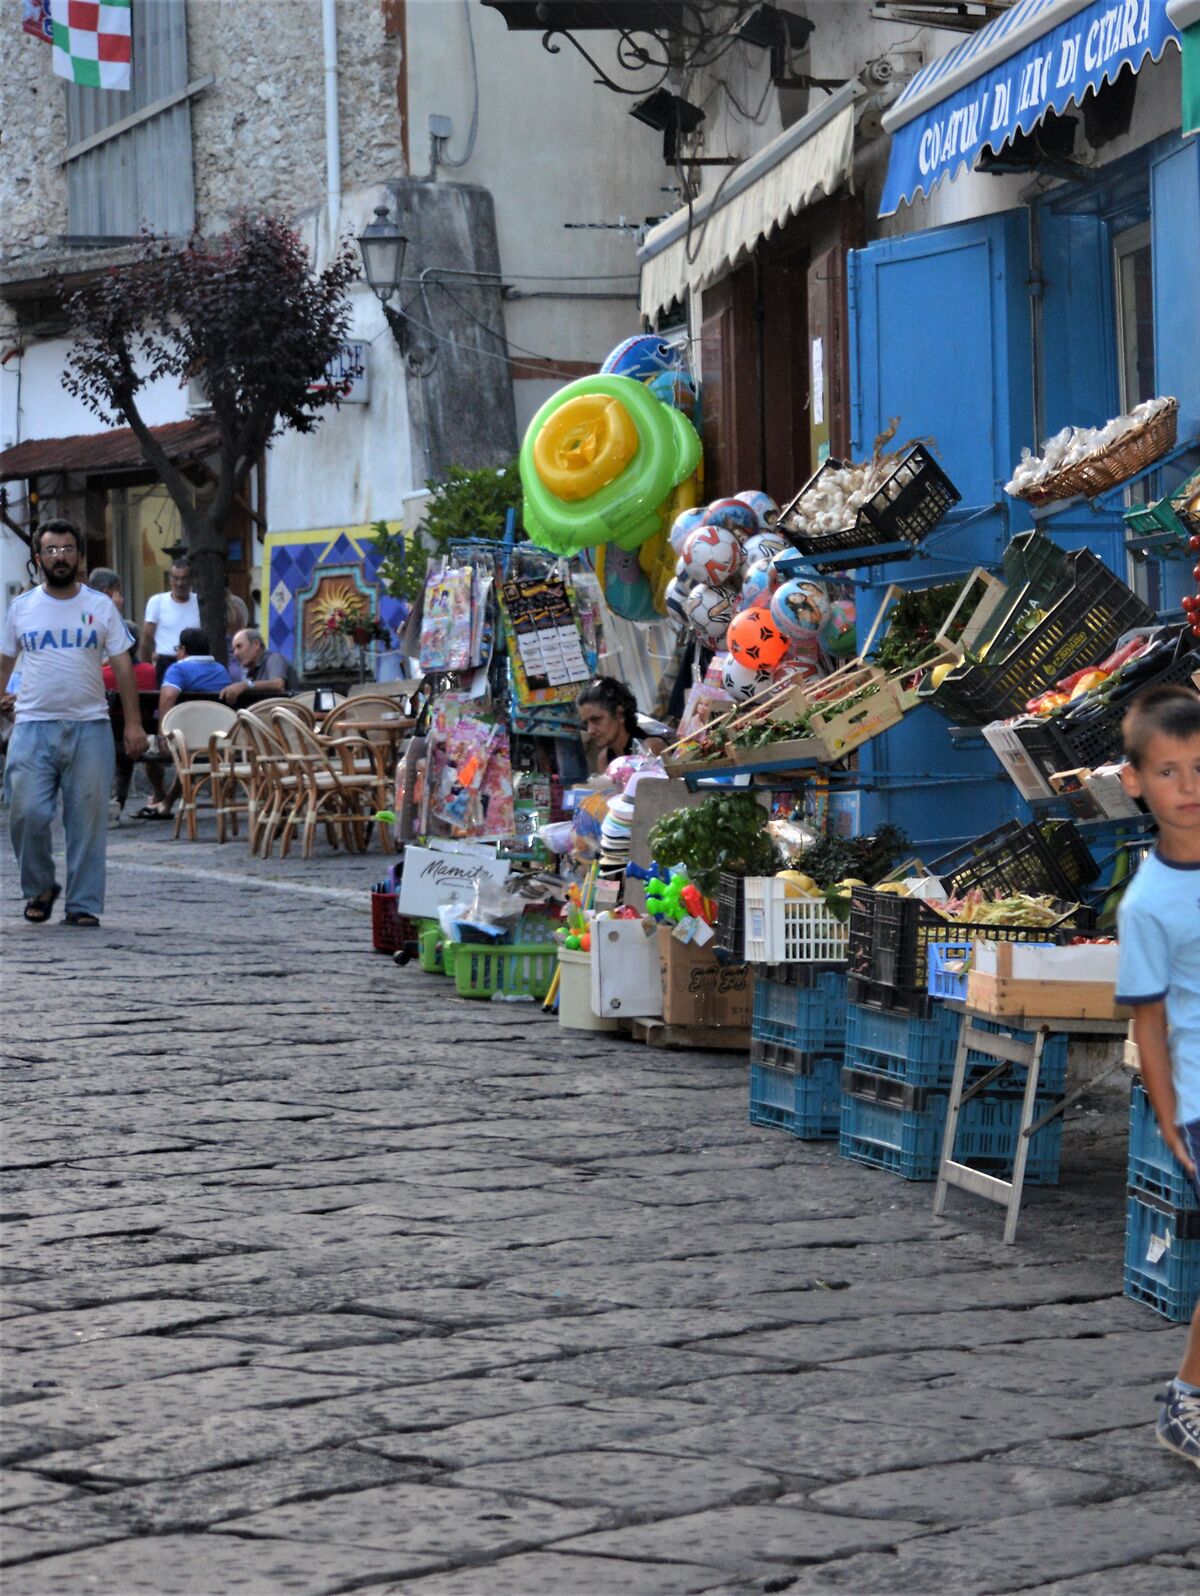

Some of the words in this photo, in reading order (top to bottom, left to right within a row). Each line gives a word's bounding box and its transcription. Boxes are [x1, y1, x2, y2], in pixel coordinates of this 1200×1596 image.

[918, 92, 989, 176] COATUR
[990, 78, 1011, 131] DI
[1016, 51, 1053, 115] LIC
[1056, 33, 1082, 88] DI
[23, 628, 98, 653] ITALIA
